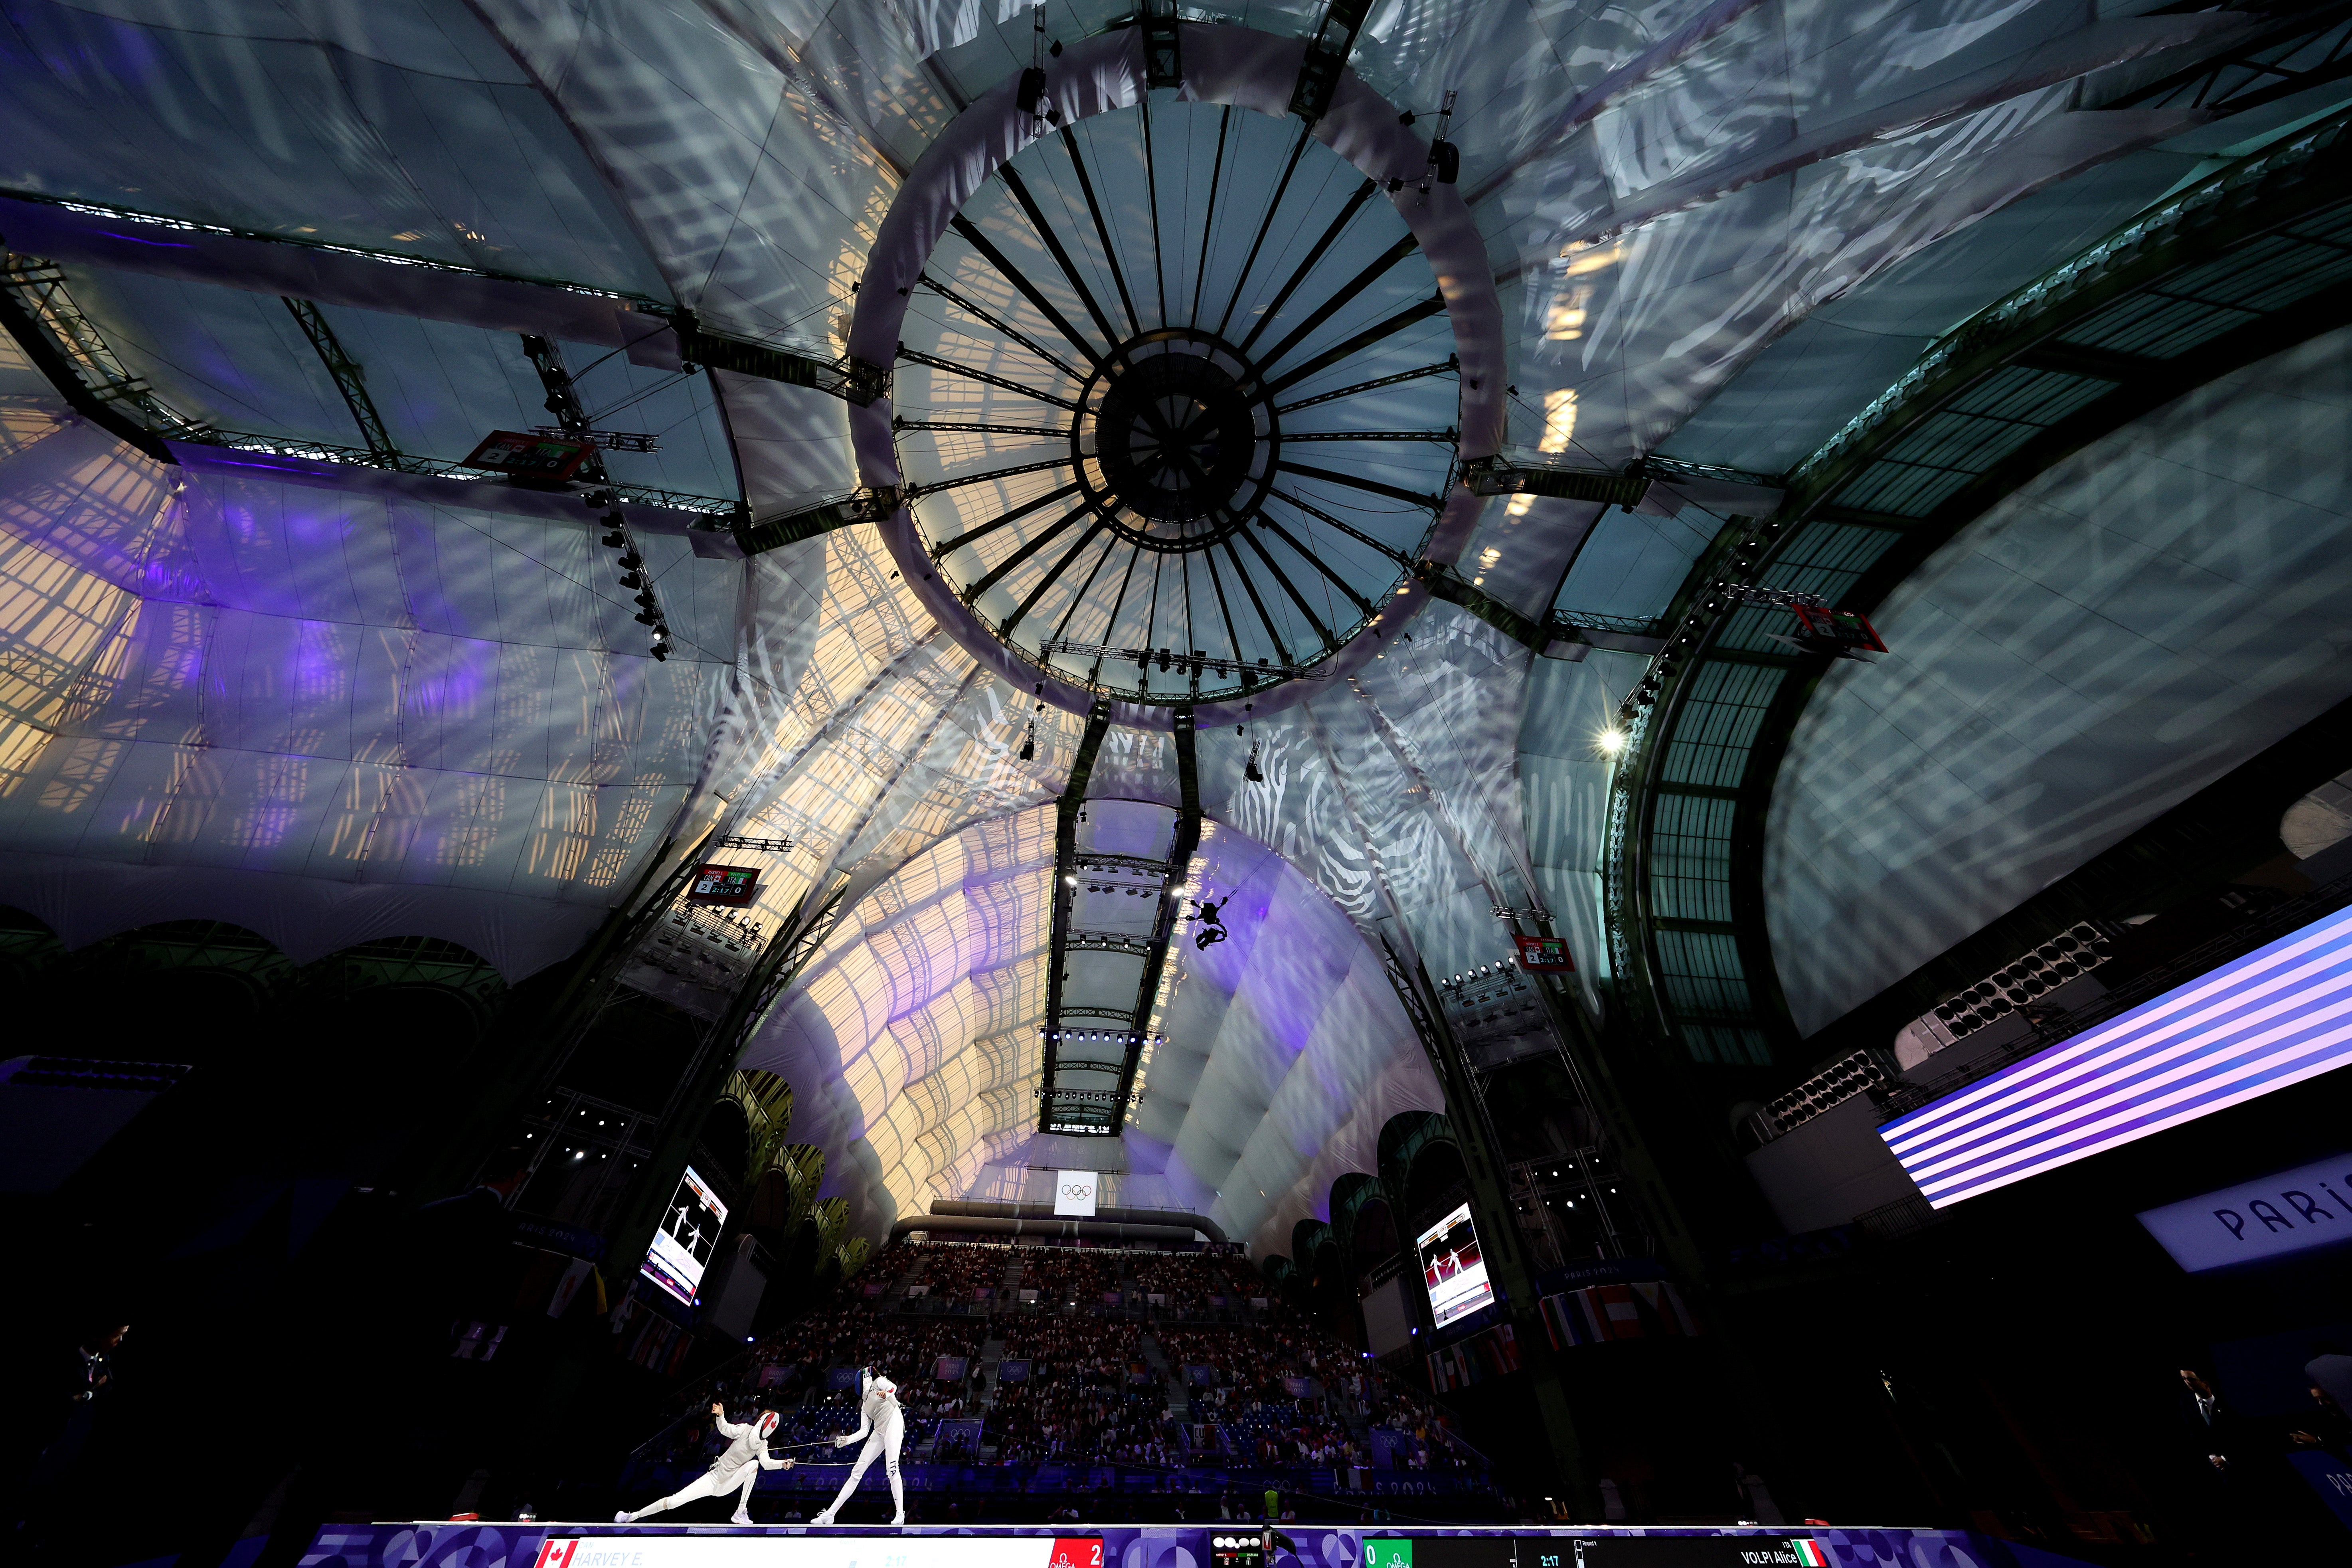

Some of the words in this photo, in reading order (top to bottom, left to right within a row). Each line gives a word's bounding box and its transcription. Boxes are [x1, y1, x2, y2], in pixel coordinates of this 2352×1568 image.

[506, 457, 537, 466] 2:17
[548, 1229, 575, 1242] 2024
[1565, 1269, 1591, 1280] PARIS
[1593, 1265, 1619, 1275] 2024
[1391, 1481, 1437, 1495] 2024
[572, 1552, 630, 1566] HARVEY
[631, 1552, 642, 1566] E.
[1090, 1545, 1101, 1565] 2
[1366, 1544, 1376, 1565] 0
[1541, 1555, 1558, 1566] 2:17
[1741, 1551, 1774, 1564] VOLPI
[1775, 1551, 1798, 1563] Alice
